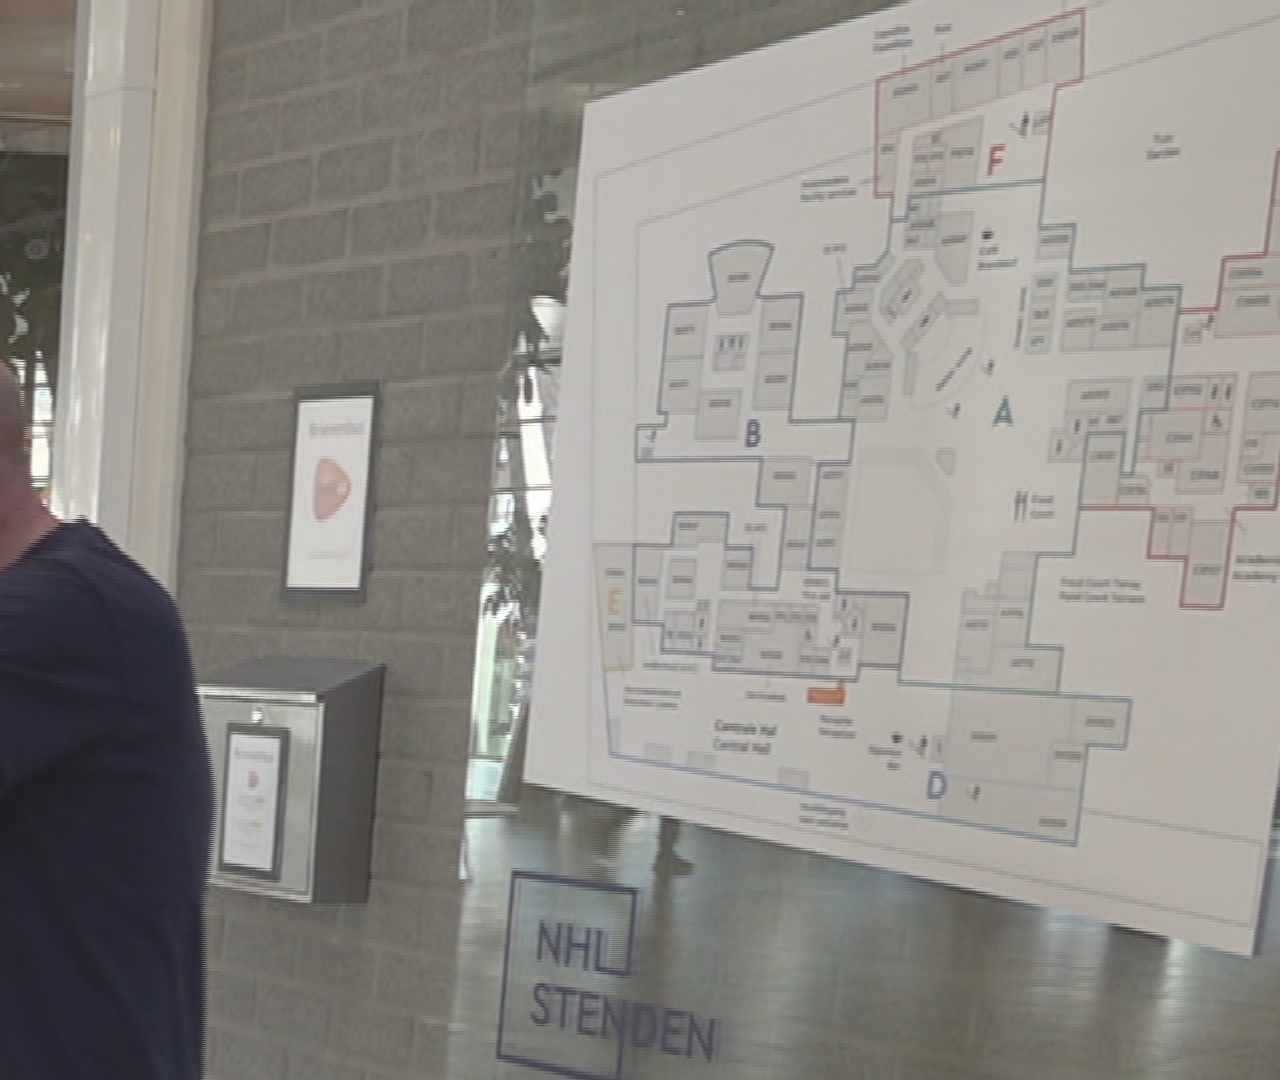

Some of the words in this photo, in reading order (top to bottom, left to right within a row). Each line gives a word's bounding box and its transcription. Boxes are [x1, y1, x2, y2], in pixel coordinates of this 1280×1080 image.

[987, 143, 1007, 178] F
[992, 396, 1014, 427] A
[744, 418, 762, 448] B
[927, 770, 948, 800] D
[536, 921, 631, 976] NHL
[530, 982, 716, 1062] STENDEN
